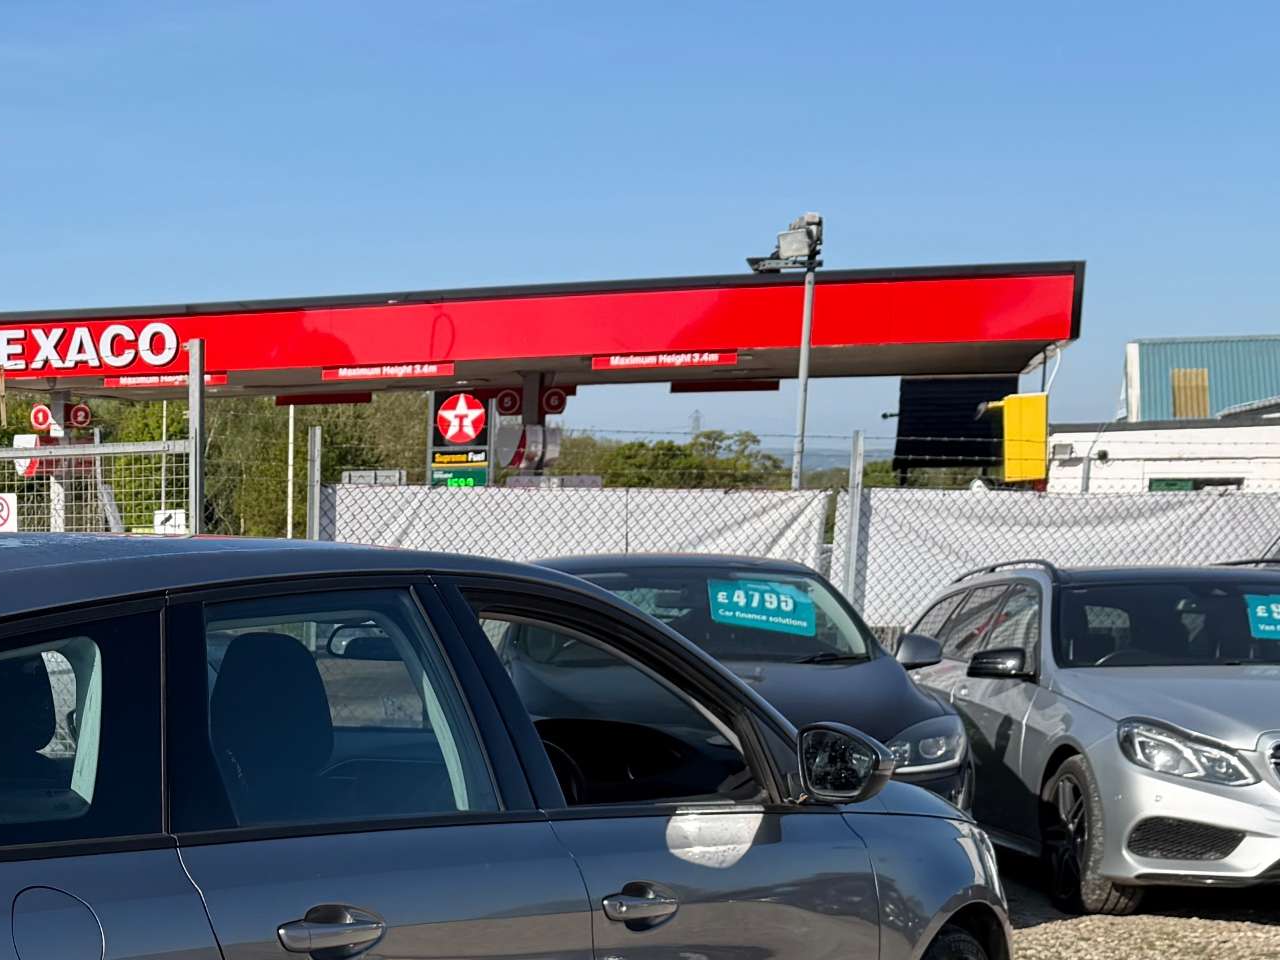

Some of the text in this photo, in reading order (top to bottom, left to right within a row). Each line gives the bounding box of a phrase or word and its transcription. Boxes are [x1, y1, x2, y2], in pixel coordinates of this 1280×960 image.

[610, 353, 719, 366] Maximum Height 3.4m
[338, 364, 437, 377] Maximum Height 3.4m
[120, 376, 159, 384] Maximum
[735, 610, 767, 621] finance
[769, 616, 808, 627] solutions
